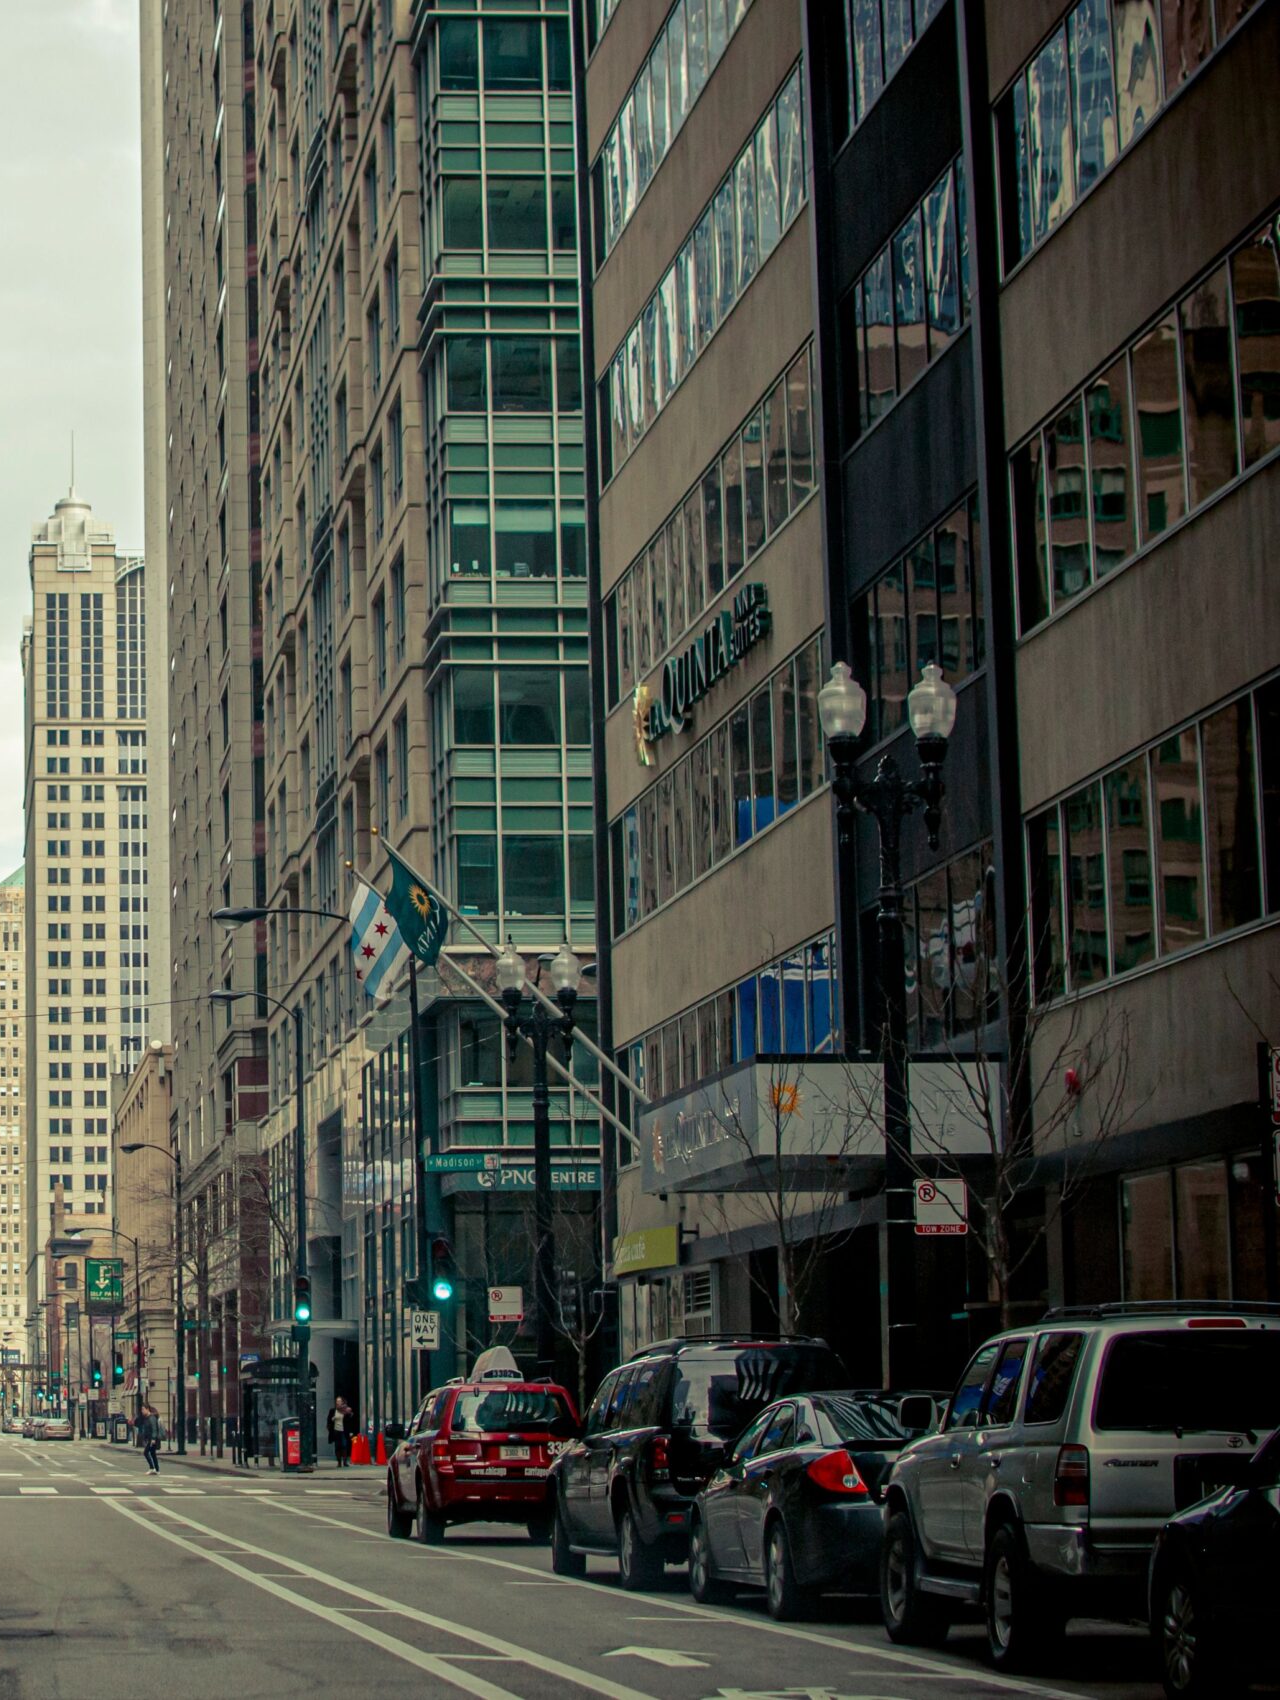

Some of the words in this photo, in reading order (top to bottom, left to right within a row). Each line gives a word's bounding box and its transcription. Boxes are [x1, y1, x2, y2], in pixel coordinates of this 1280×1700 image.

[729, 608, 770, 663] SUITES
[661, 611, 732, 735] QUINTA
[436, 1157, 474, 1167] Madison
[550, 1172, 596, 1184] ENTRE
[921, 1225, 937, 1233] TOW
[939, 1225, 961, 1233] ZONE
[414, 1314, 436, 1323] ONE
[414, 1324, 437, 1334] WAY
